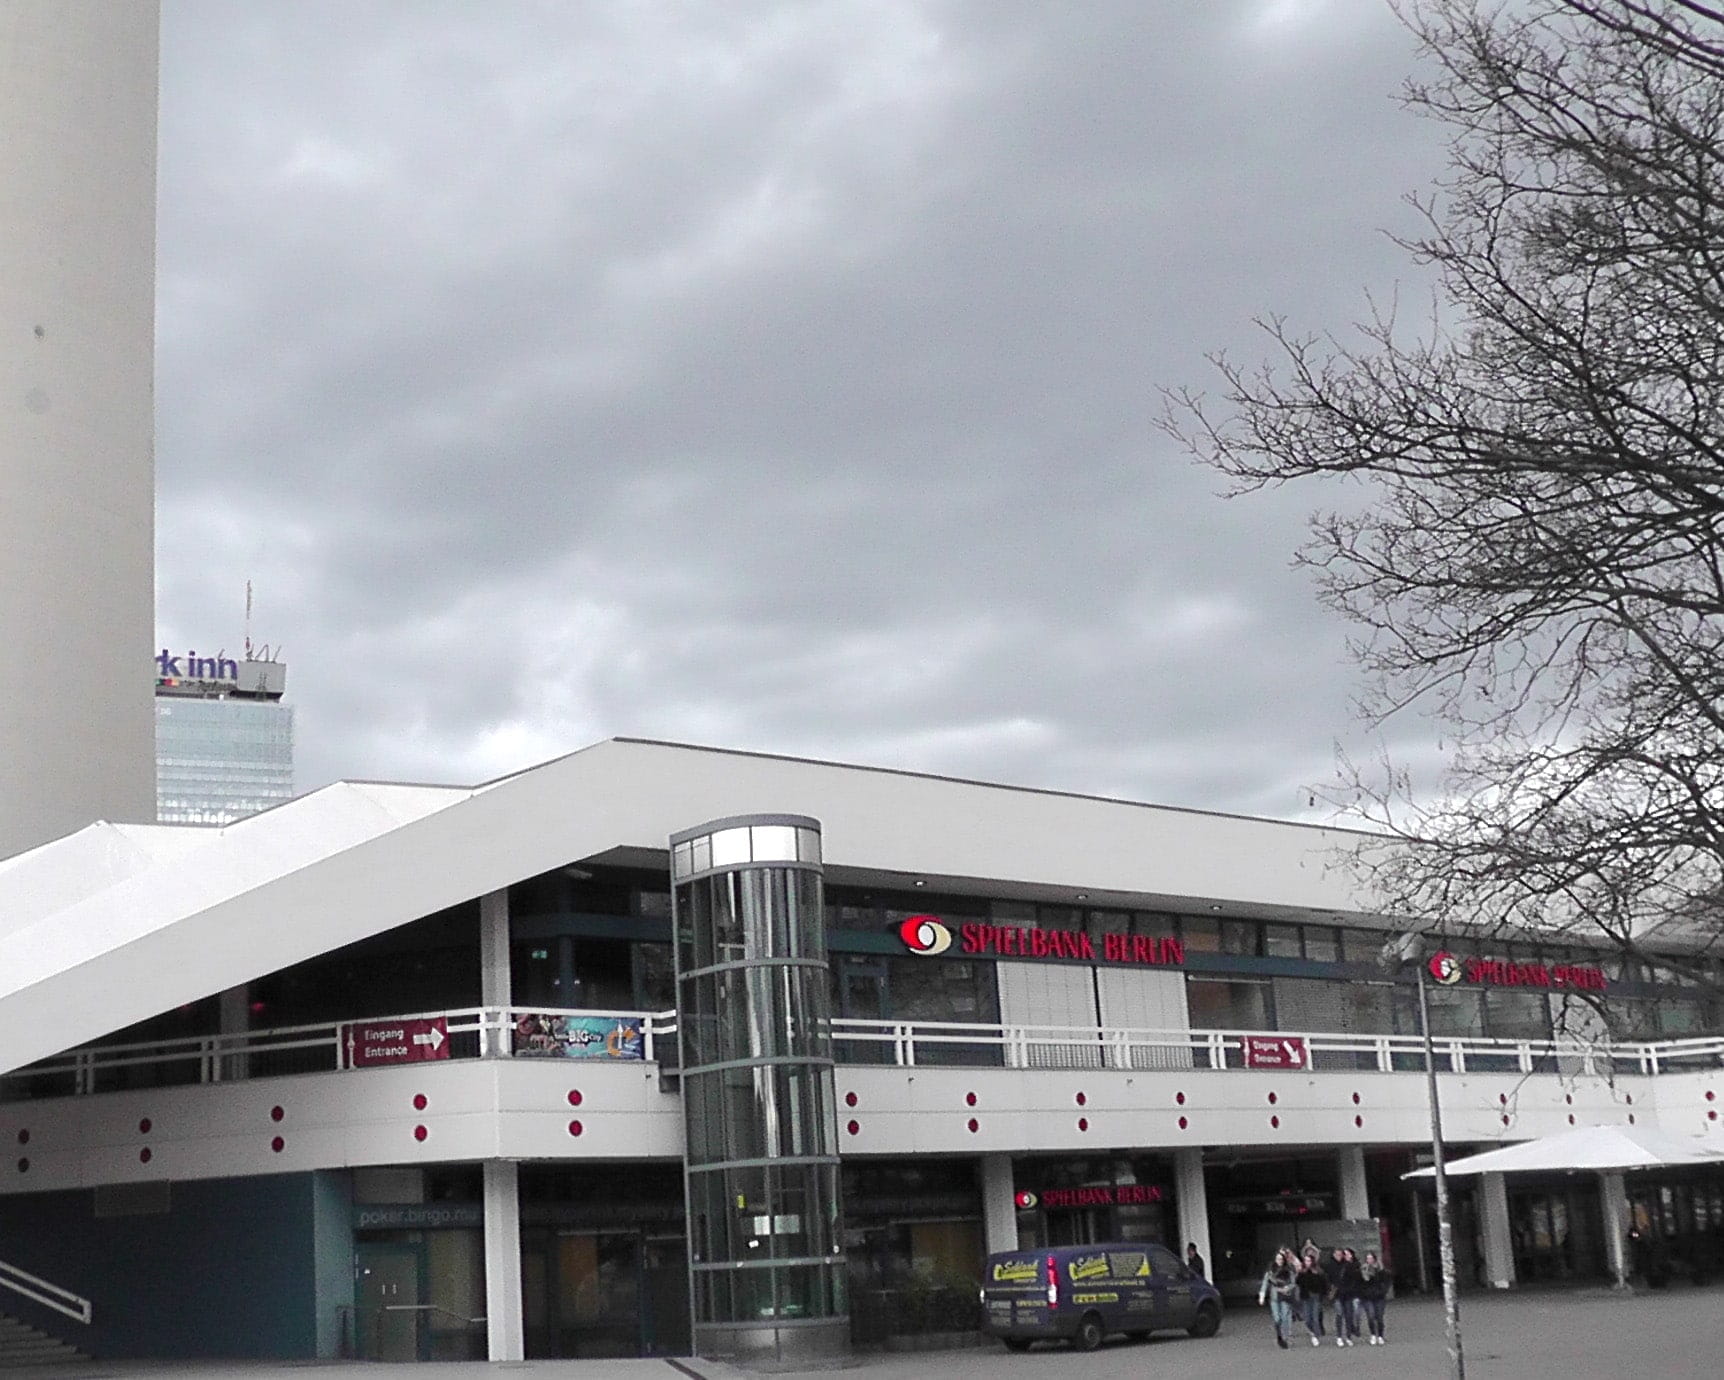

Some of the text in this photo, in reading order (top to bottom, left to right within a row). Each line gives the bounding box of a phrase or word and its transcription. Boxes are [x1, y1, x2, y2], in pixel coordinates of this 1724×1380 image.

[155, 649, 238, 679] k inn
[961, 923, 1185, 965] SPIELBANK BERLIN
[365, 1028, 405, 1042] Eingang
[365, 1045, 408, 1058] Entrance
[1042, 1185, 1161, 1208] SPIELBANK BERLIN
